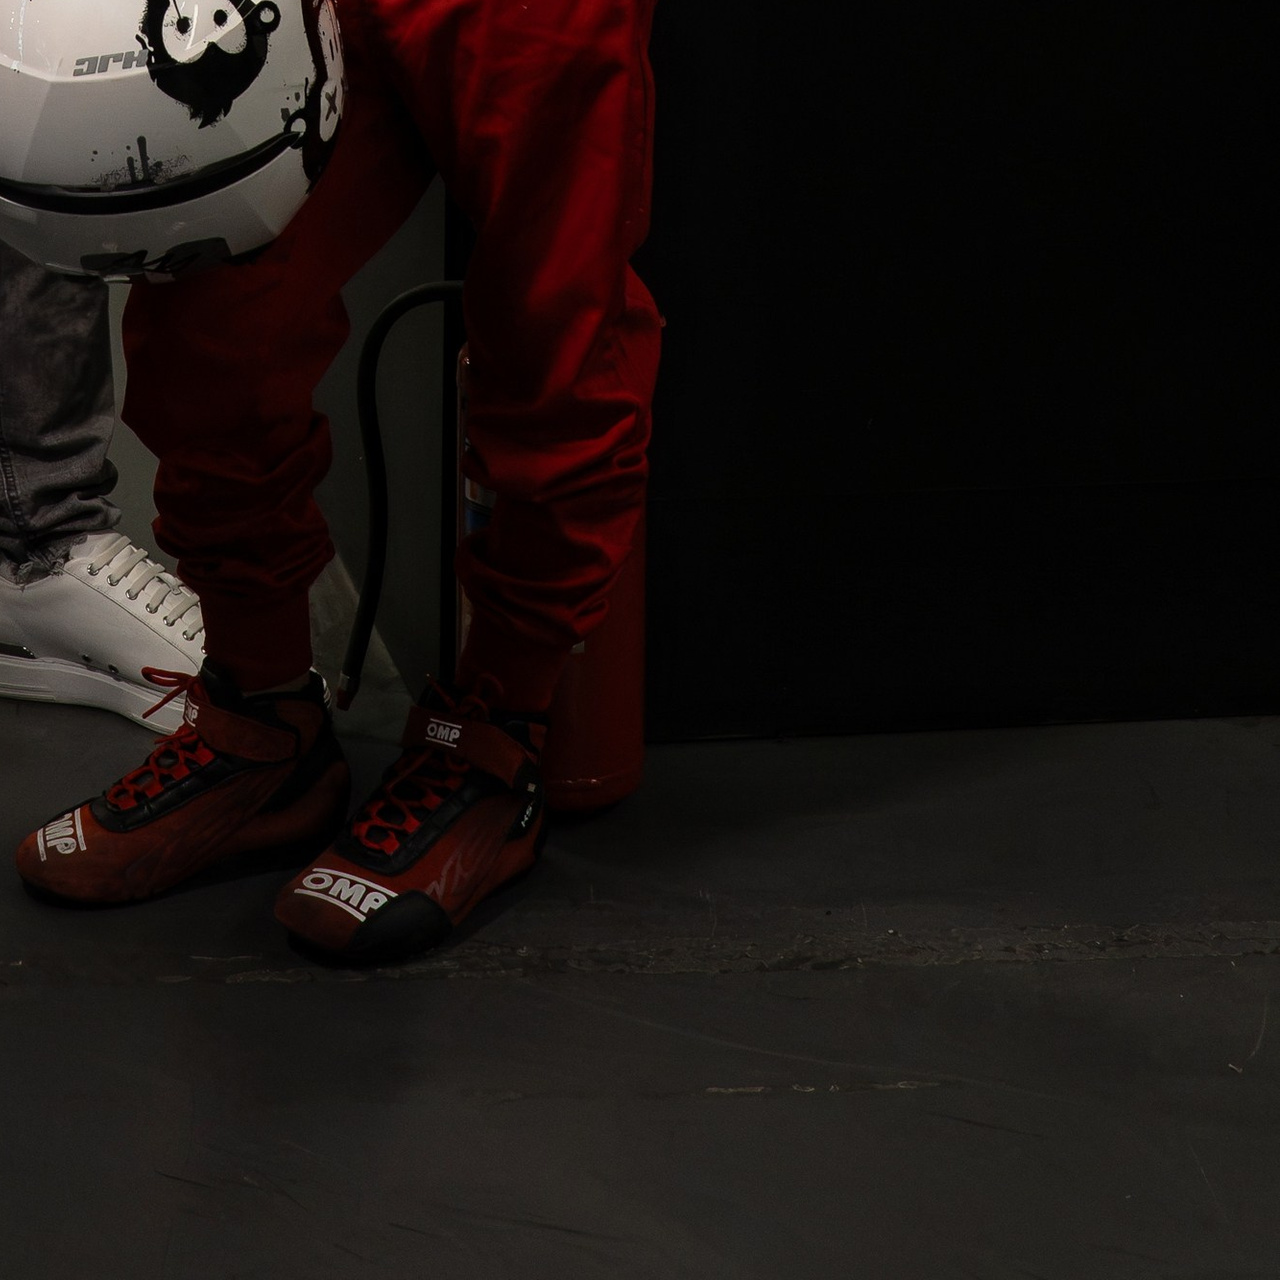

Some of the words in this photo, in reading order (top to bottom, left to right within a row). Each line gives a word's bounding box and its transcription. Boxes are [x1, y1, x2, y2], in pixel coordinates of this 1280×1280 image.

[73, 49, 149, 77] HJC
[426, 722, 463, 744] OMP
[302, 870, 389, 915] OMP
